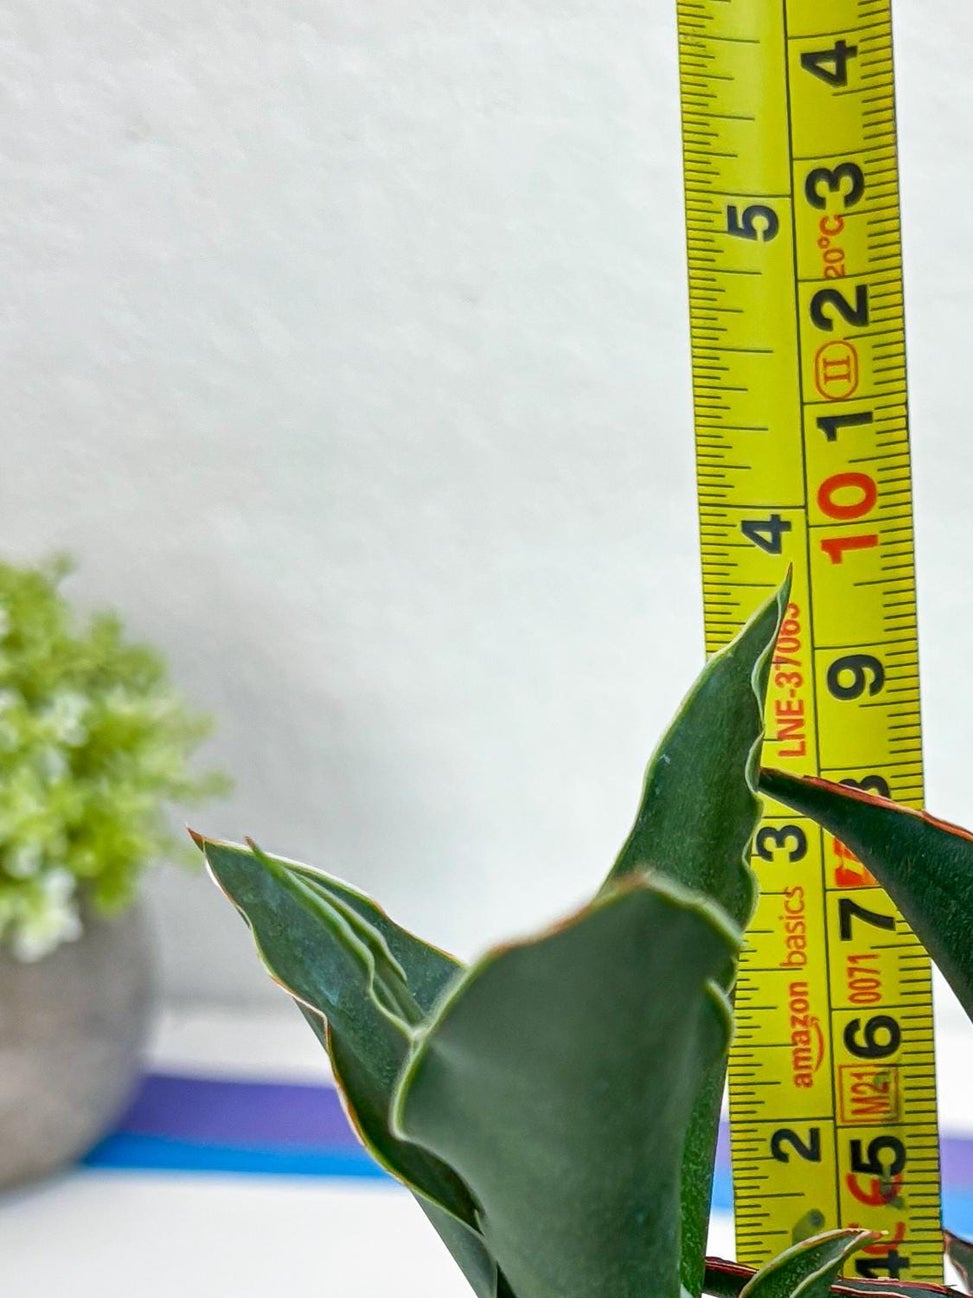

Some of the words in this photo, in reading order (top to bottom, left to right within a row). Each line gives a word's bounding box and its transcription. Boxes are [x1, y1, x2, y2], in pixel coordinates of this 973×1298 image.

[800, 39, 858, 87] 4
[805, 162, 865, 209] 3
[726, 204, 779, 242] 5
[810, 284, 869, 332] 2
[816, 411, 874, 442] 1
[741, 513, 792, 555] 4
[817, 472, 878, 564] 10
[826, 654, 885, 701] 9
[755, 824, 808, 863] 3
[778, 886, 809, 969] basics
[838, 898, 896, 941] 7
[847, 953, 882, 1005] 0071
[788, 981, 814, 1089] amazon
[843, 1014, 901, 1060] 6
[850, 1072, 891, 1117] M21
[771, 1127, 822, 1164] 2
[849, 1135, 907, 1176] 5
